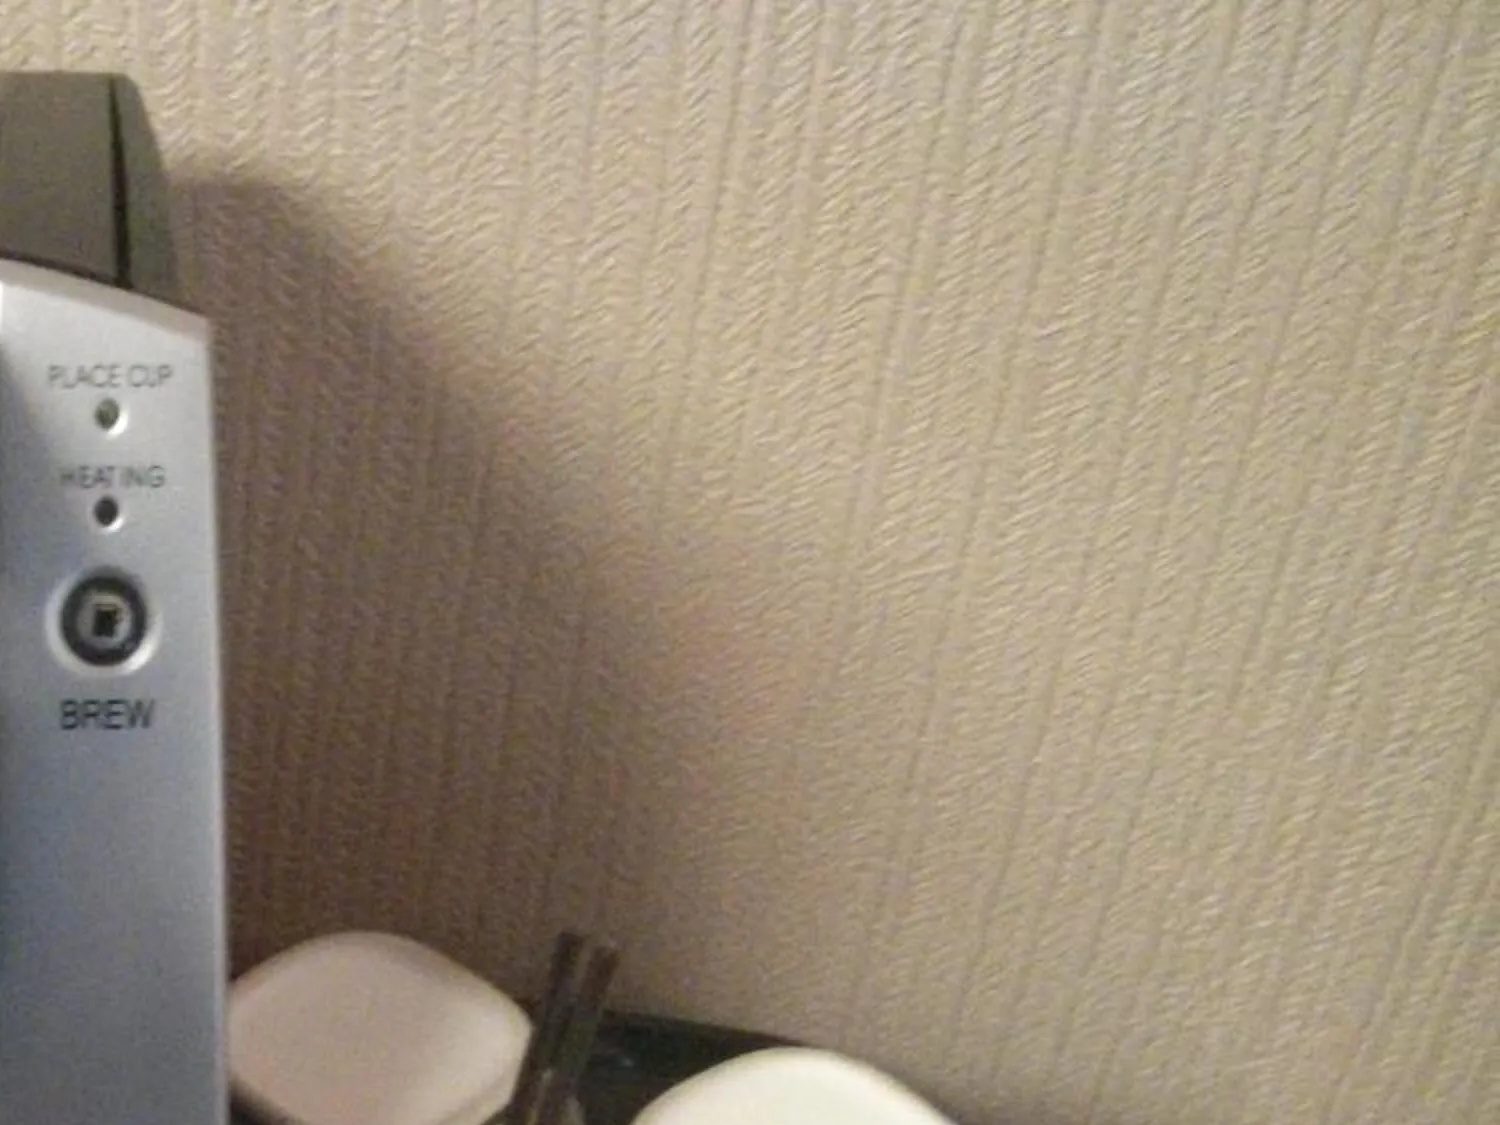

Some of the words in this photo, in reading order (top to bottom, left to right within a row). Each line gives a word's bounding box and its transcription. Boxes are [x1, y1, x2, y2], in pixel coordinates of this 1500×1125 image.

[47, 363, 121, 390] PLACE
[127, 363, 173, 390] CUP
[59, 464, 166, 489] HEATING
[60, 699, 156, 731] BREW
